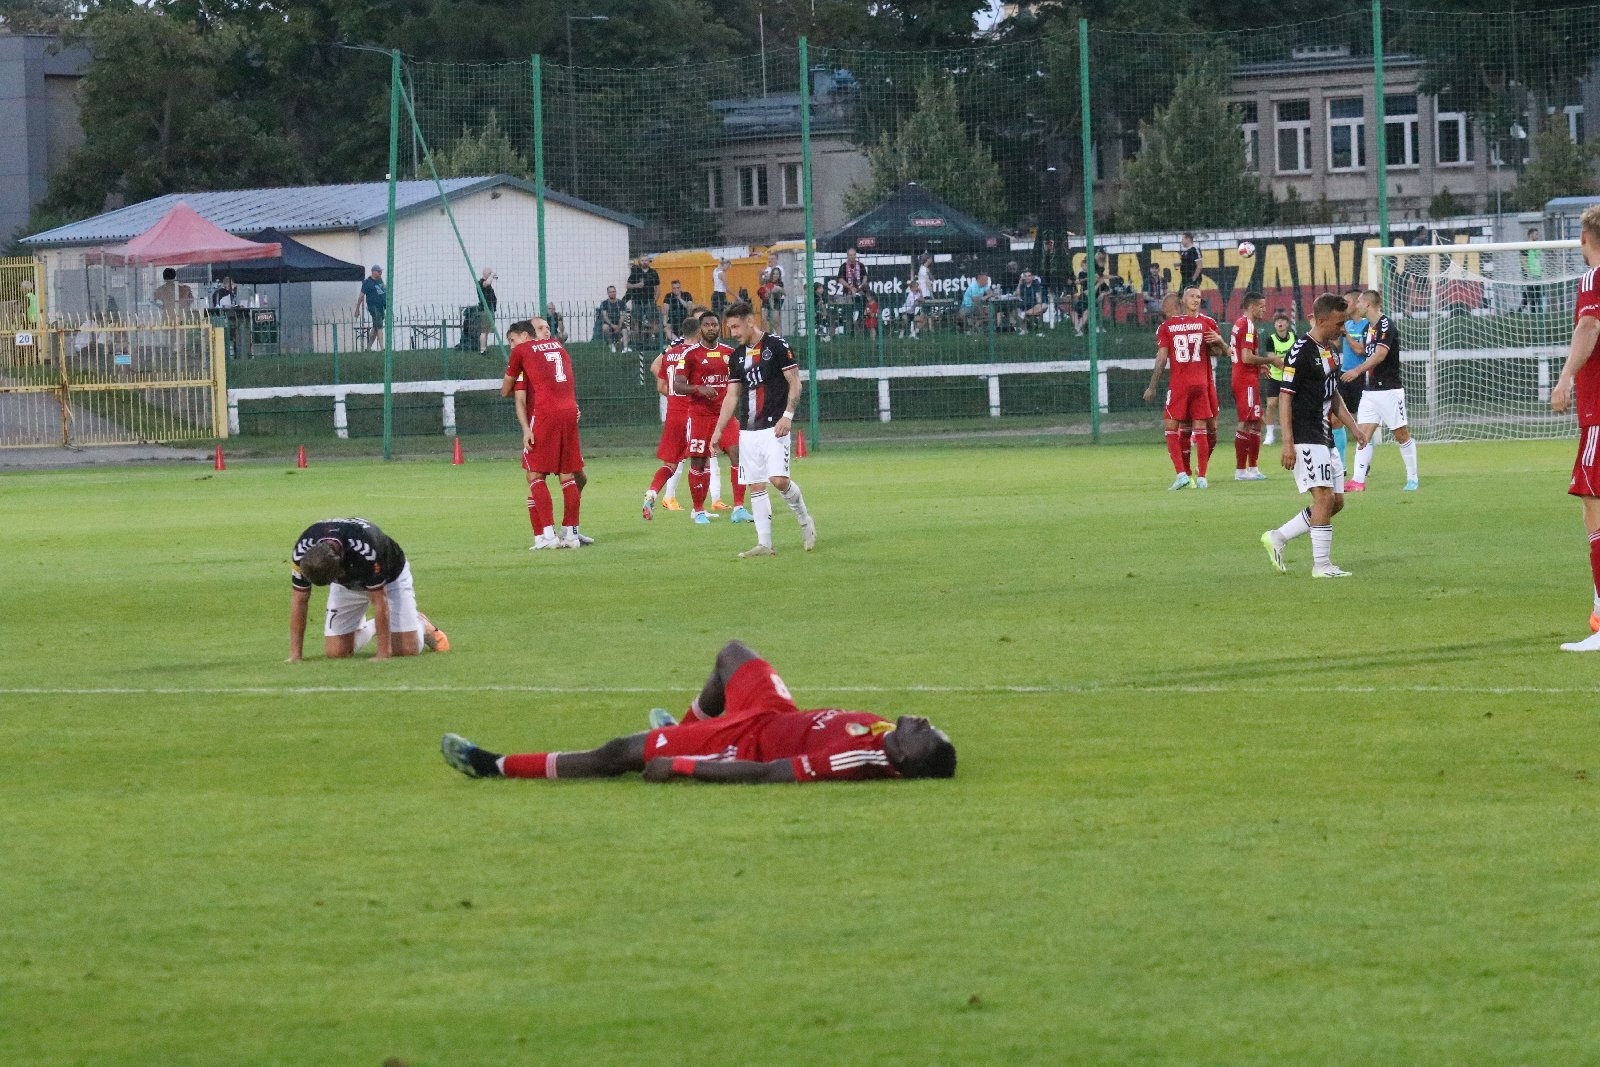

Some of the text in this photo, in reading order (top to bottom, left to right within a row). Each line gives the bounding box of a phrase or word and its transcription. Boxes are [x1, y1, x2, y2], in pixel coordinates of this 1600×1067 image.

[19, 334, 30, 344] 20
[1173, 333, 1203, 363] 87
[543, 351, 568, 383] 7
[689, 438, 706, 454] 23
[1317, 463, 1331, 481] 16
